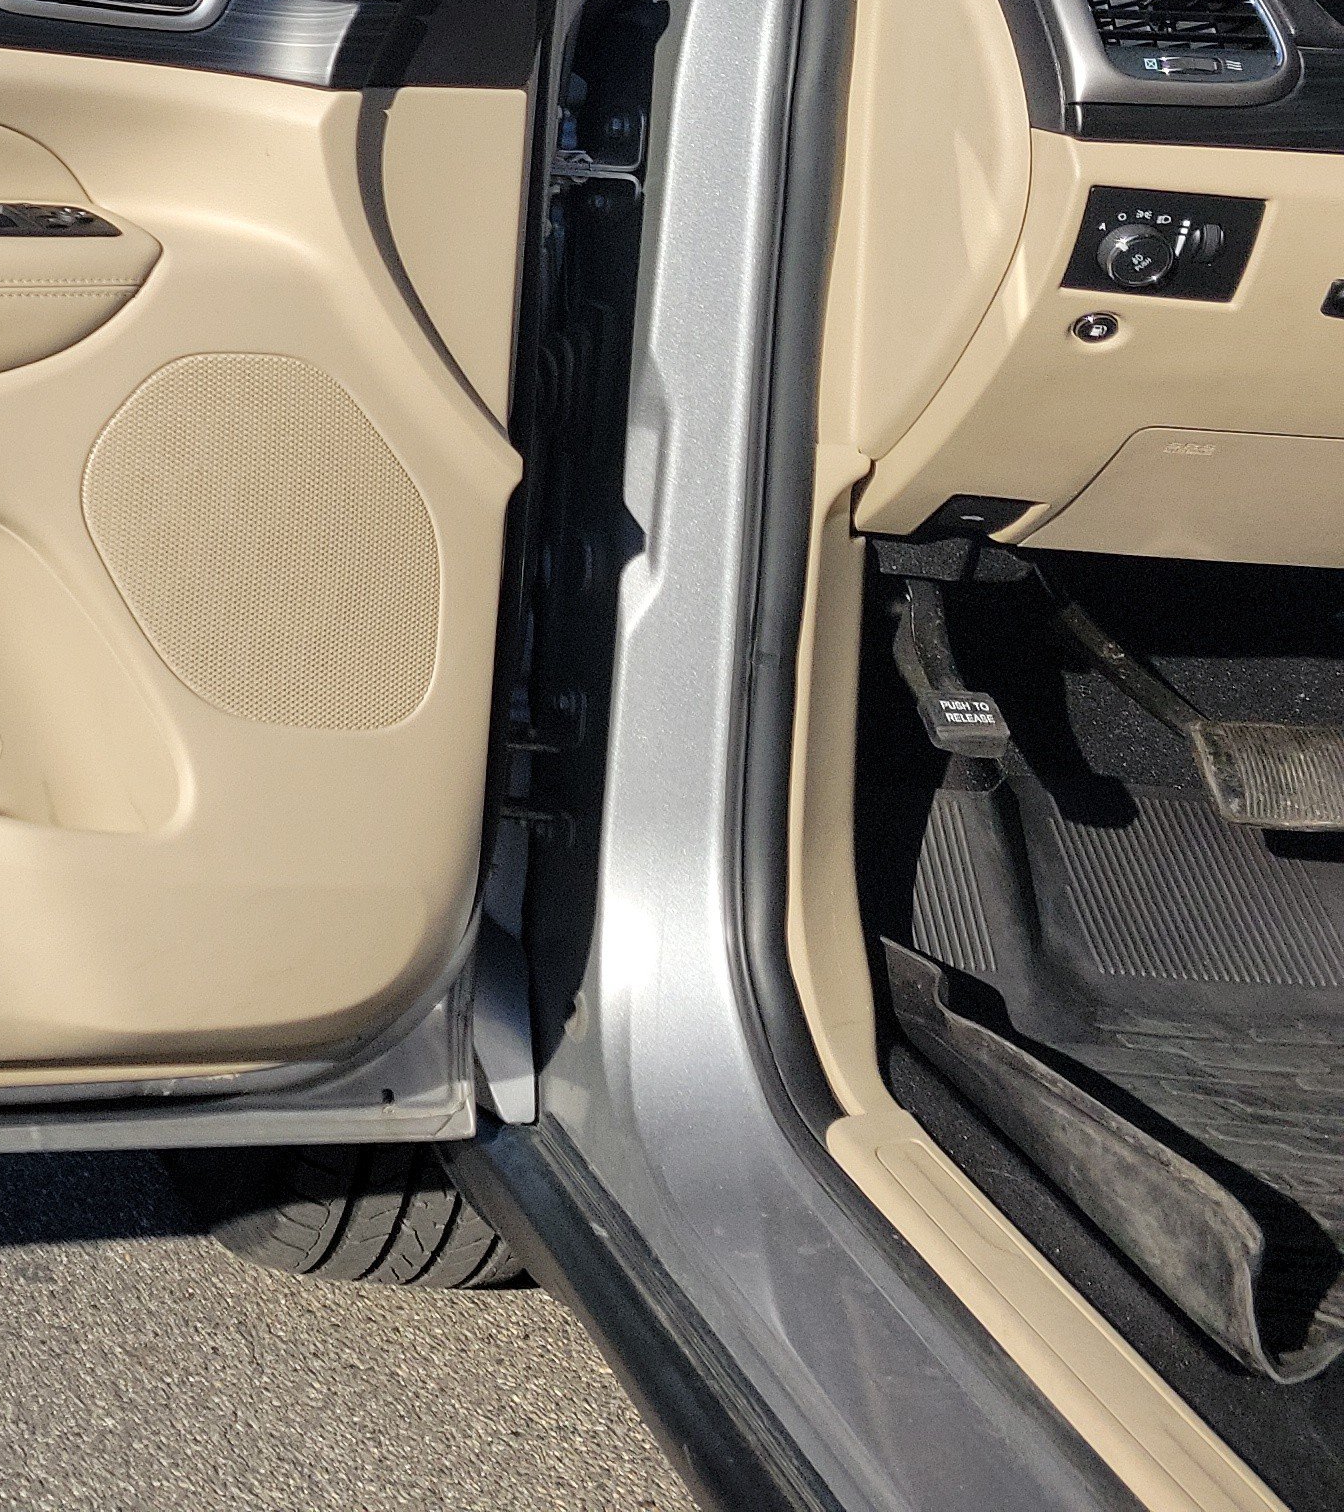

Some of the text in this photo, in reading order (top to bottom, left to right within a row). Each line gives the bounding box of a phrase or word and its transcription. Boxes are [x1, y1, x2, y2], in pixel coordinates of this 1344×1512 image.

[939, 699, 990, 712] PUSH TO
[945, 712, 996, 724] RELEASE
